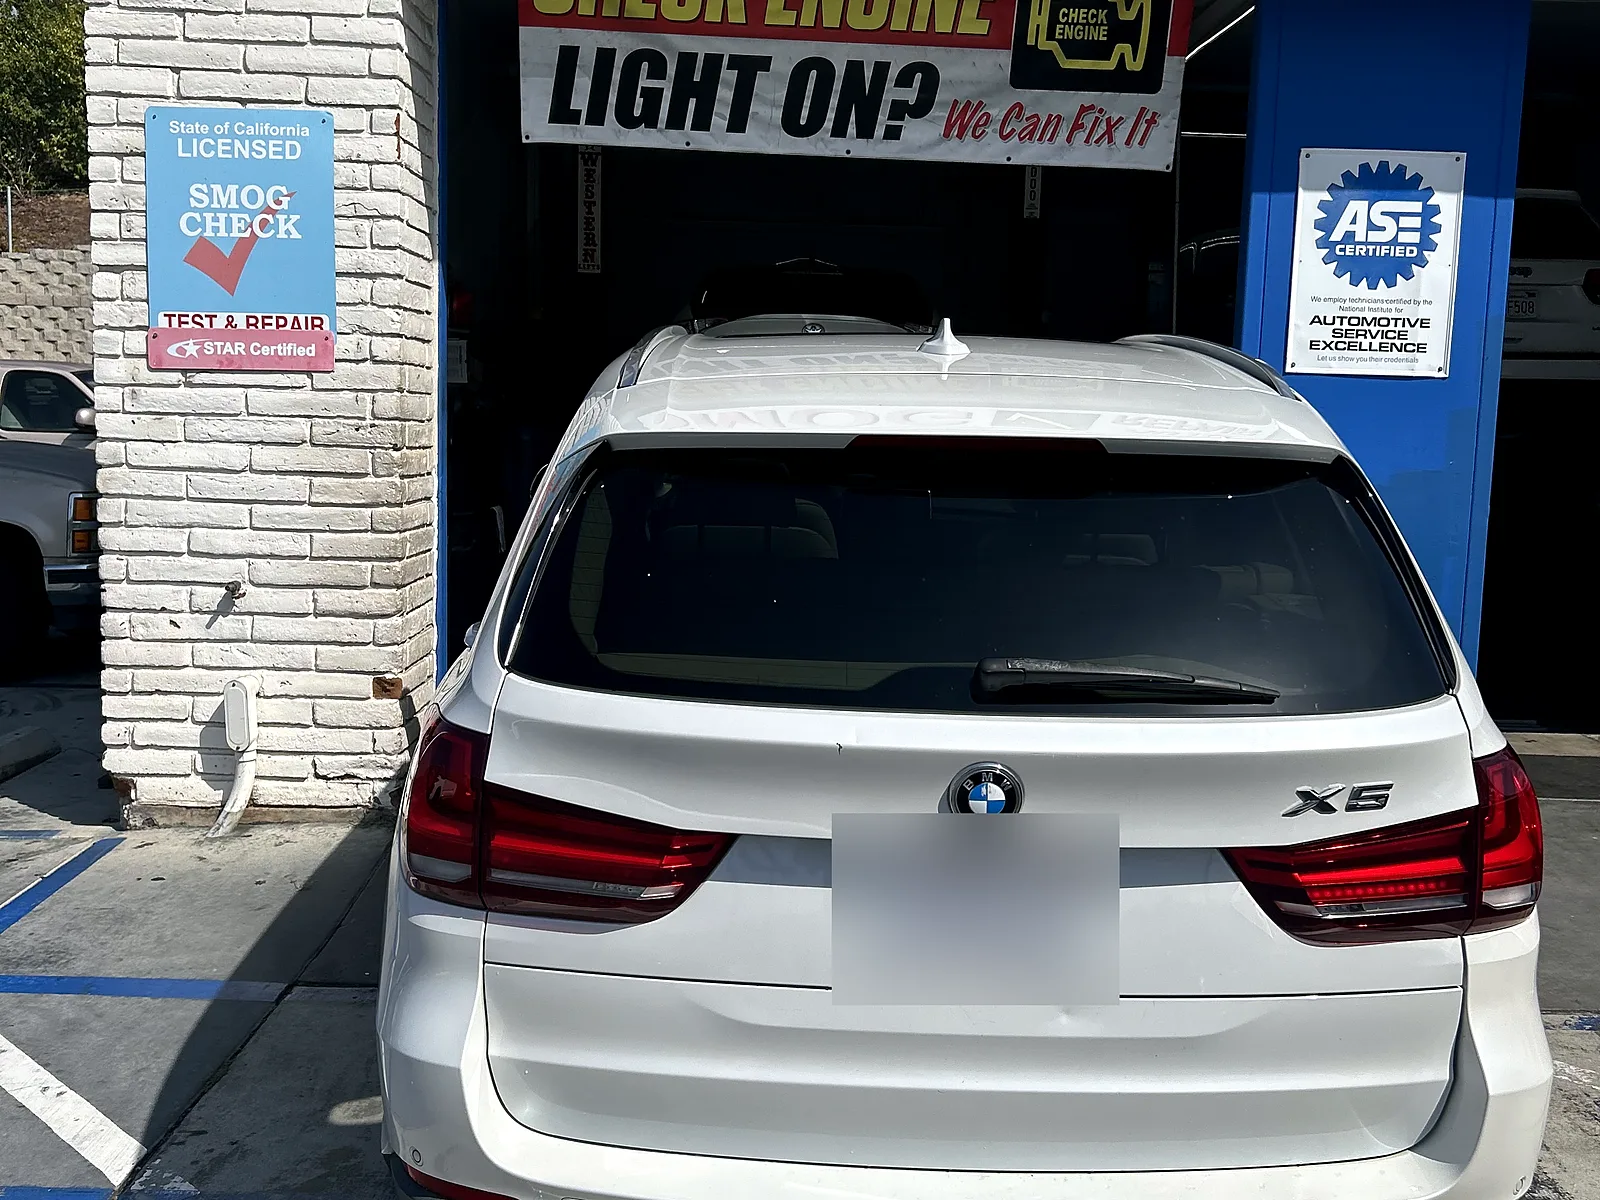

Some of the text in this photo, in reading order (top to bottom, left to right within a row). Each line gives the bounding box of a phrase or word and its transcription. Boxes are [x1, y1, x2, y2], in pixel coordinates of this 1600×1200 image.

[1058, 7, 1108, 24] CHECK
[1055, 24, 1108, 41] ENGINE
[547, 44, 940, 141] LIGHT ON?
[169, 121, 310, 137] State of California
[943, 99, 1161, 148] We Can Fix It
[177, 137, 302, 160] LICENSED
[189, 183, 291, 210] SMOG
[580, 151, 600, 264] WESTERN
[179, 212, 302, 239] CHECK
[1328, 200, 1423, 244] ASE
[1335, 244, 1418, 258] CERTIFIED
[1323, 296, 1347, 304] employ
[1339, 305, 1366, 313] National
[163, 313, 217, 328] TEST
[246, 315, 324, 331] REPAIR
[1309, 315, 1431, 328] AUTOMOTIVE
[1331, 328, 1409, 340] SERVICE
[203, 342, 316, 357] STAR Certified
[1309, 340, 1428, 353] EXCELLENCE
[1384, 356, 1419, 364] credentials
[963, 772, 1013, 791] BMW
